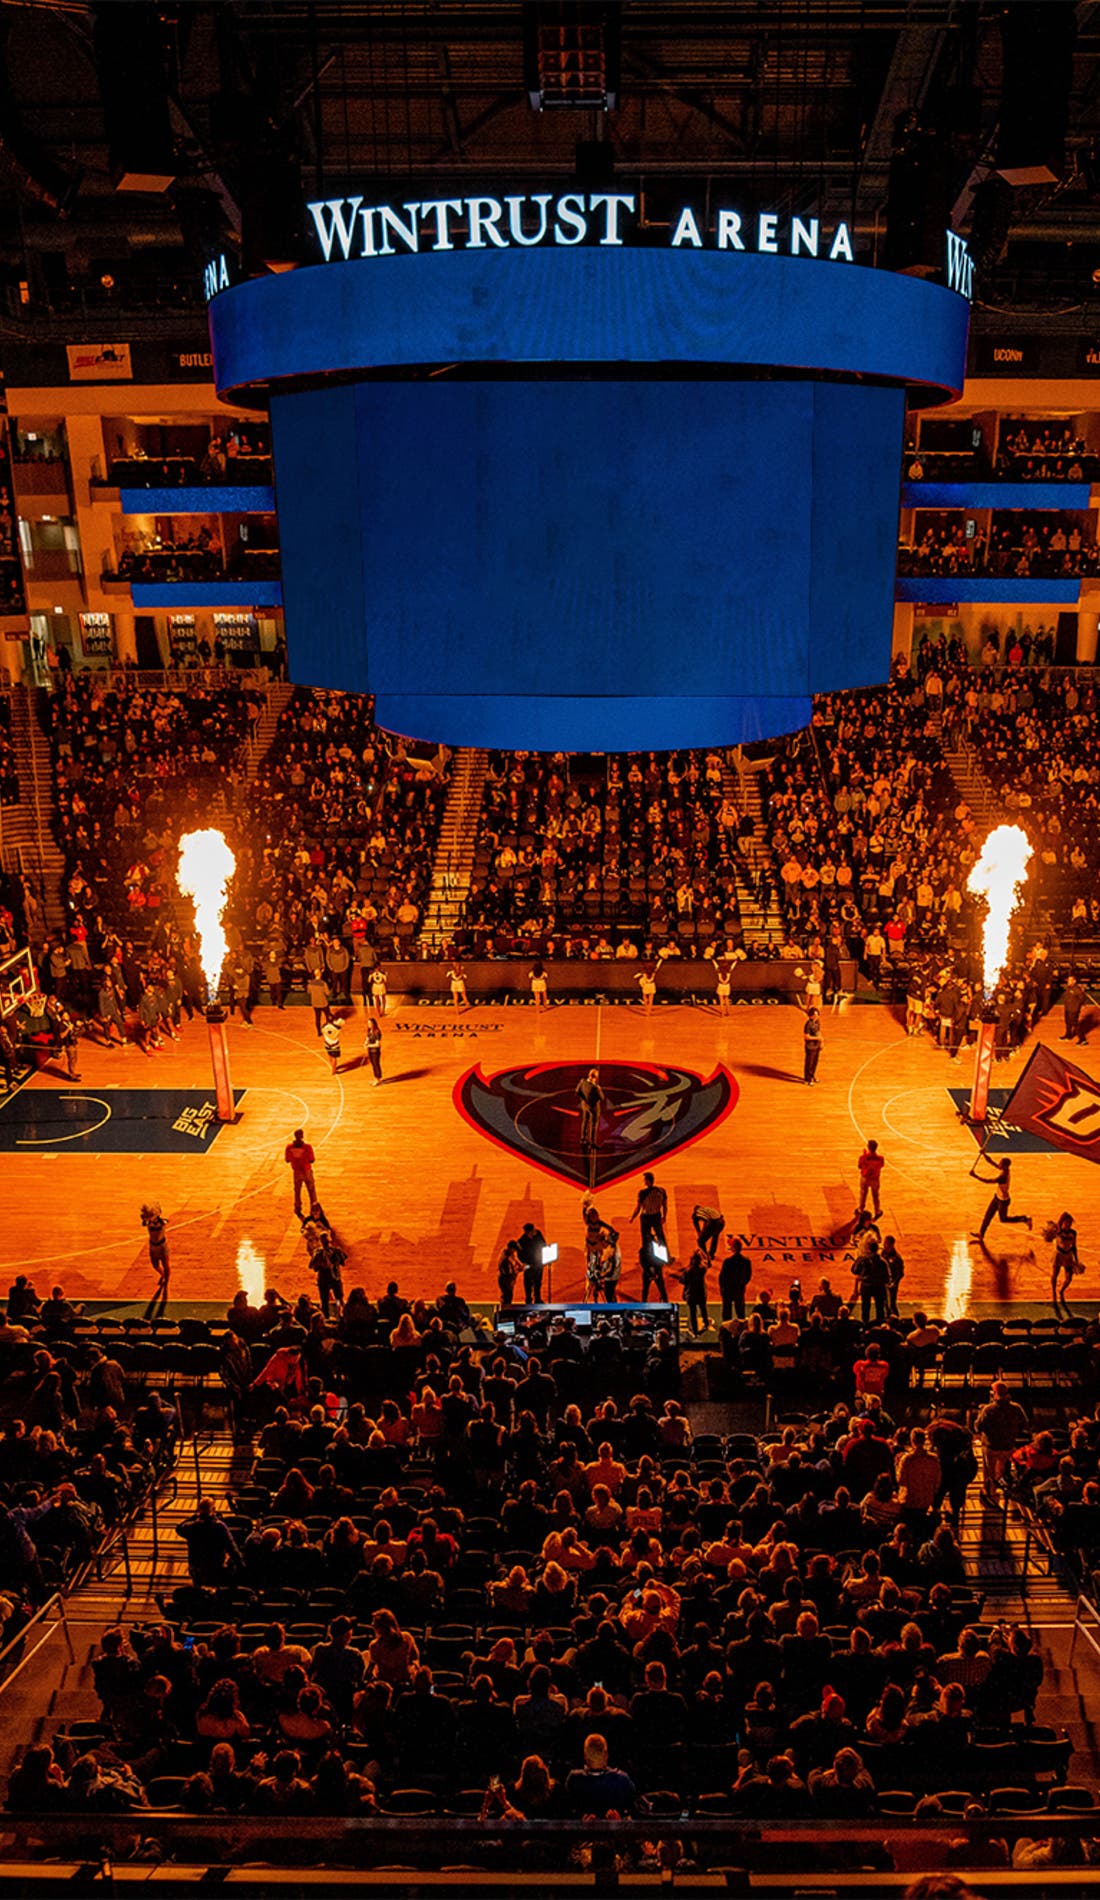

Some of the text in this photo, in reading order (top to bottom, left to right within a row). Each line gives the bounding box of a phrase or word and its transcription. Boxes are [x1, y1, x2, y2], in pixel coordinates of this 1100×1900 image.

[306, 194, 854, 262] WINTRUST ARENA
[680, 998, 780, 1006] CHIAGO
[171, 1106, 198, 1132] BIG
[185, 1101, 217, 1137] EAST
[726, 1233, 850, 1247] WINTRU
[762, 1252, 857, 1262] ARENA
